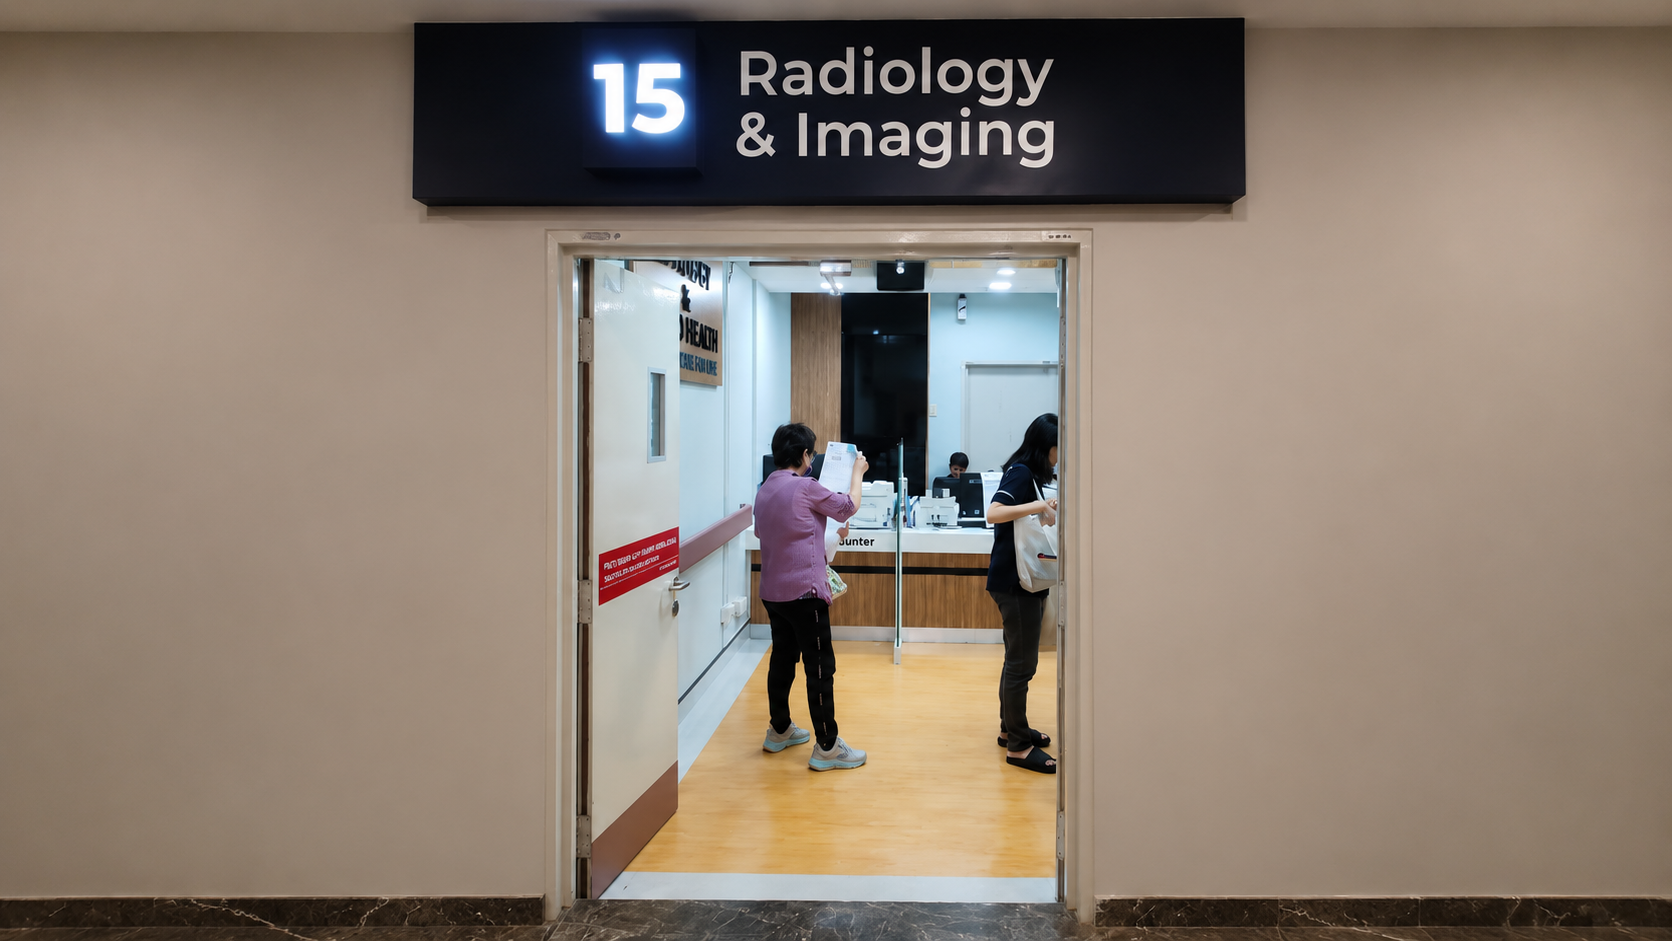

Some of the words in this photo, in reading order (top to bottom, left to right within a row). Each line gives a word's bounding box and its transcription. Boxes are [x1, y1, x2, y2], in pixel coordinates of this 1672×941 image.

[593, 62, 685, 135] 15
[740, 46, 1054, 108] Radiology
[736, 111, 775, 158] &
[799, 107, 1055, 169] Imaging
[685, 316, 718, 353] HEALTH
[839, 537, 875, 546] ounter
